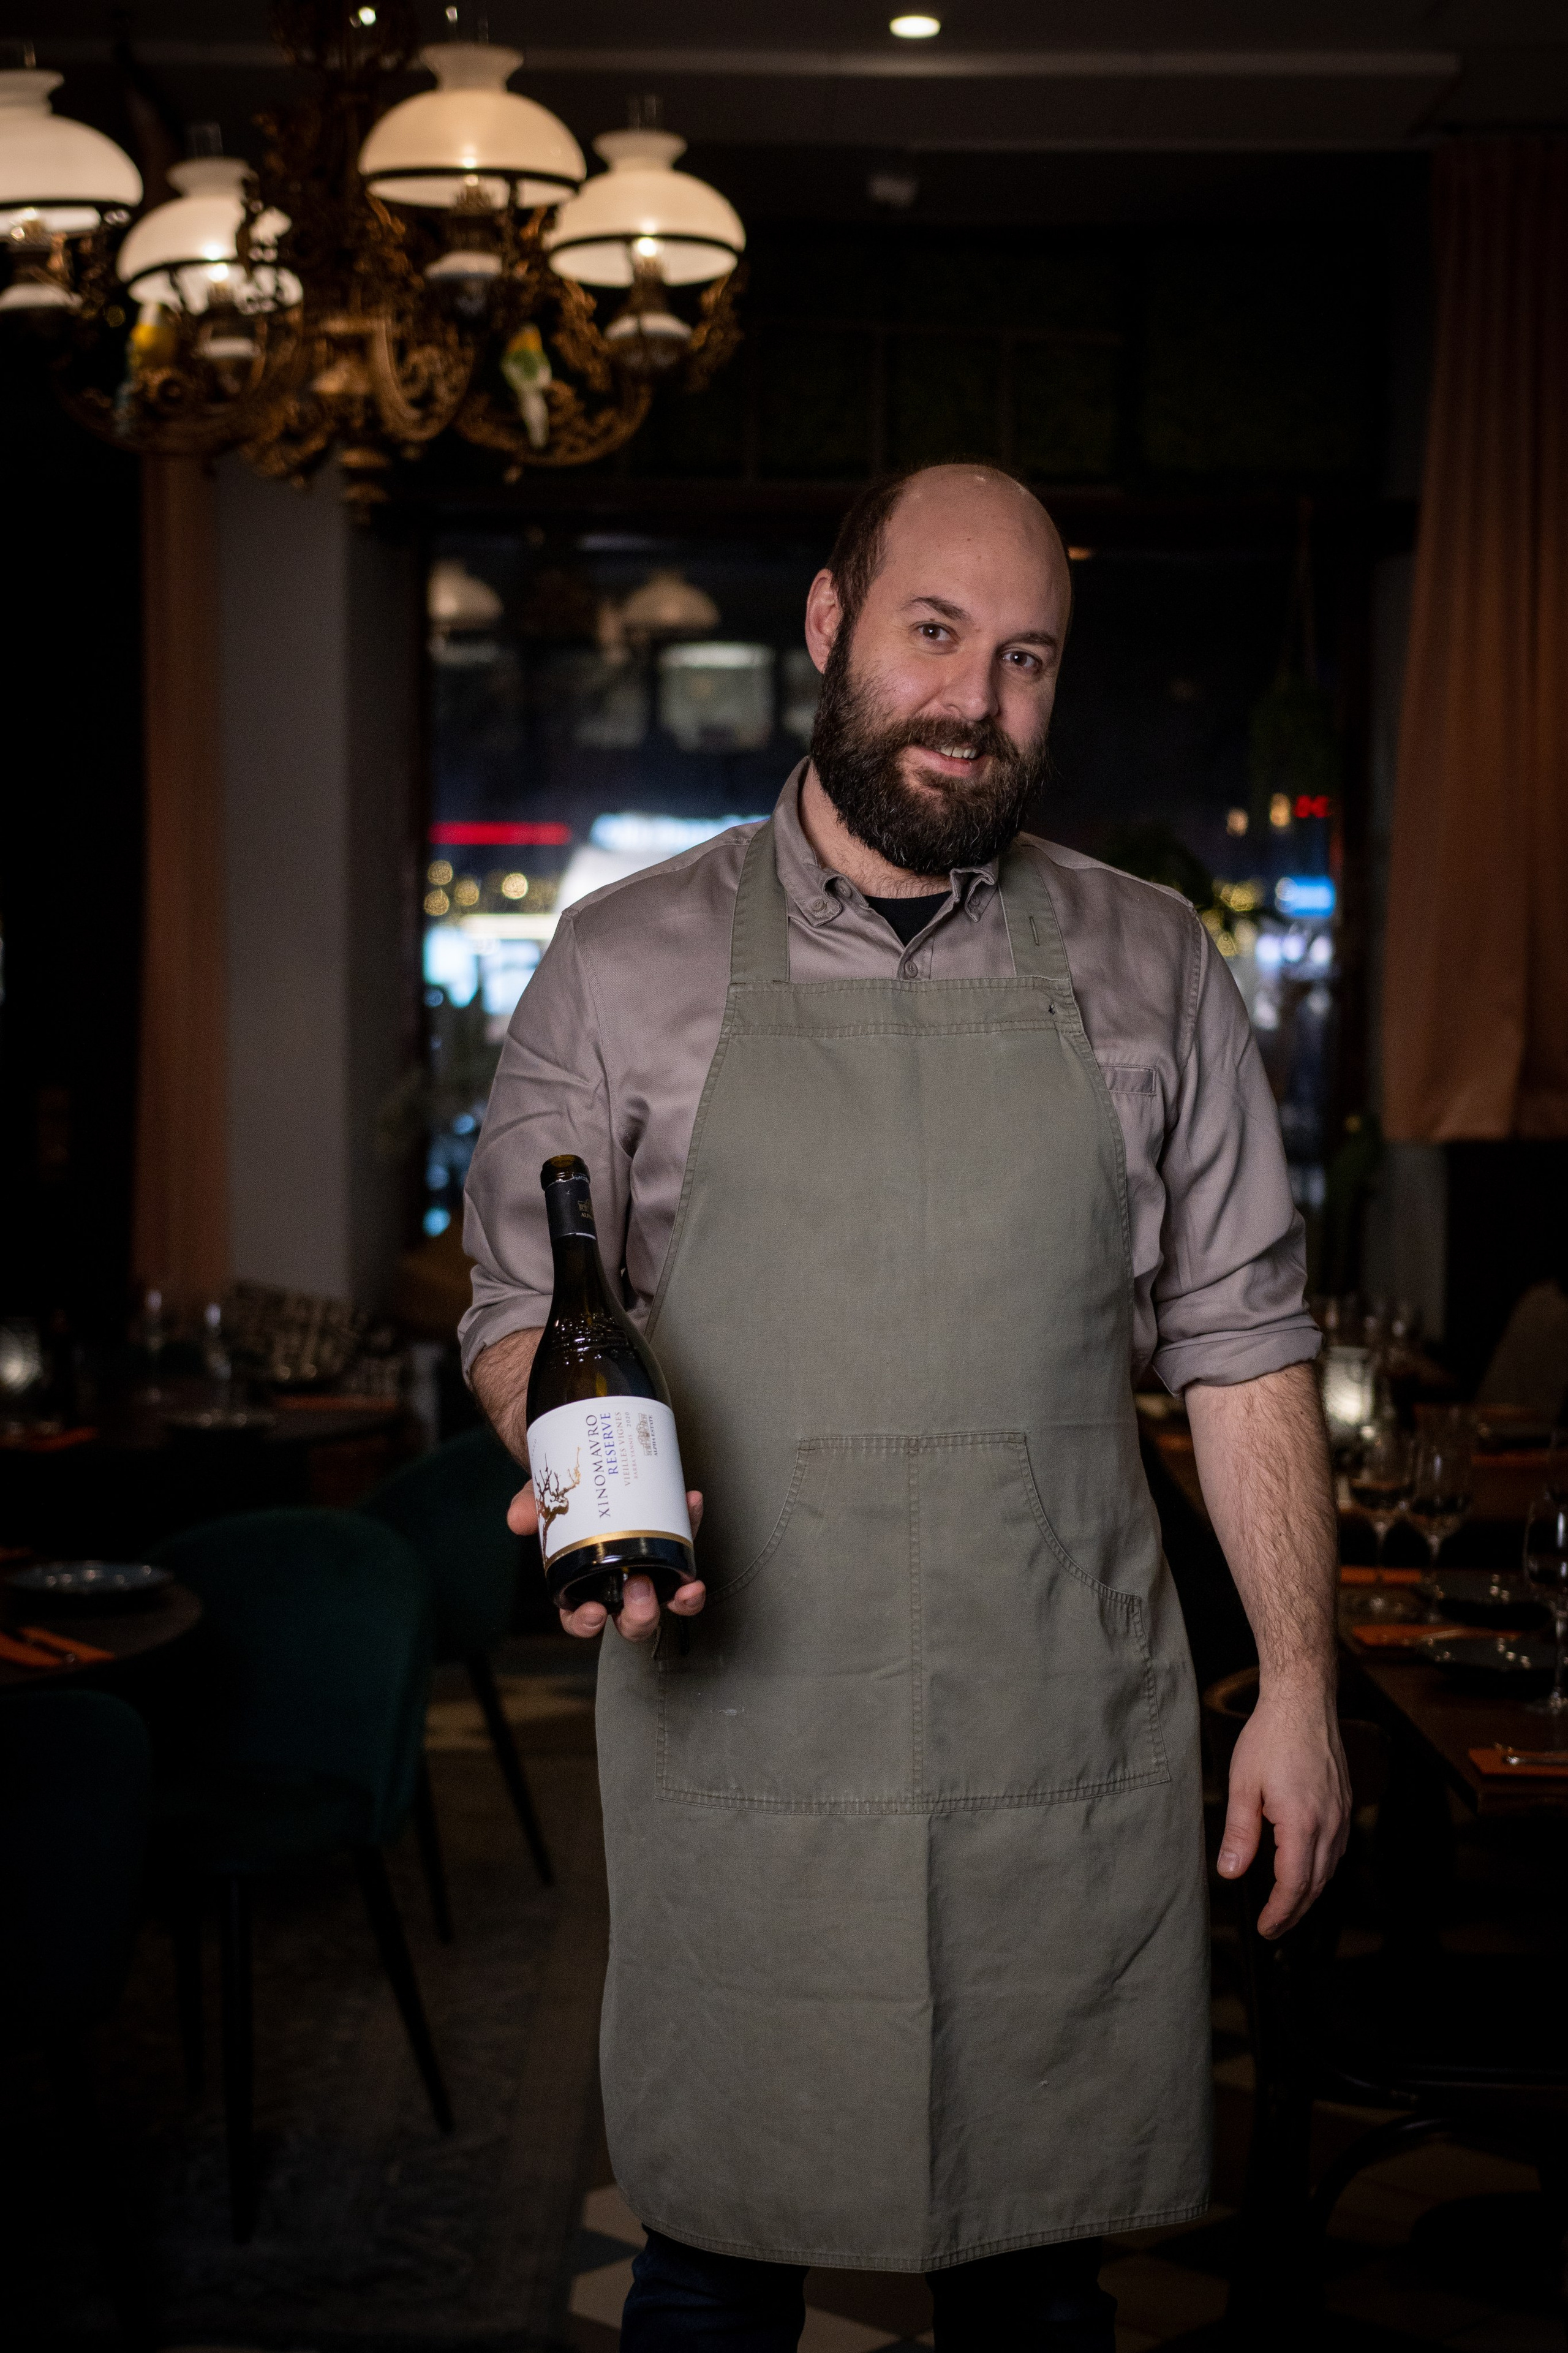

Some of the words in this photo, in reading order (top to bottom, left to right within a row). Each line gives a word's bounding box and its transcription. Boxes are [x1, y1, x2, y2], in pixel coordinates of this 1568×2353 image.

[600, 1412, 619, 1475] RESERVE
[615, 1411, 625, 1445] VIGNES
[586, 1414, 611, 1518] XINOMAVRO
[620, 1448, 630, 1486] VIEILLES
